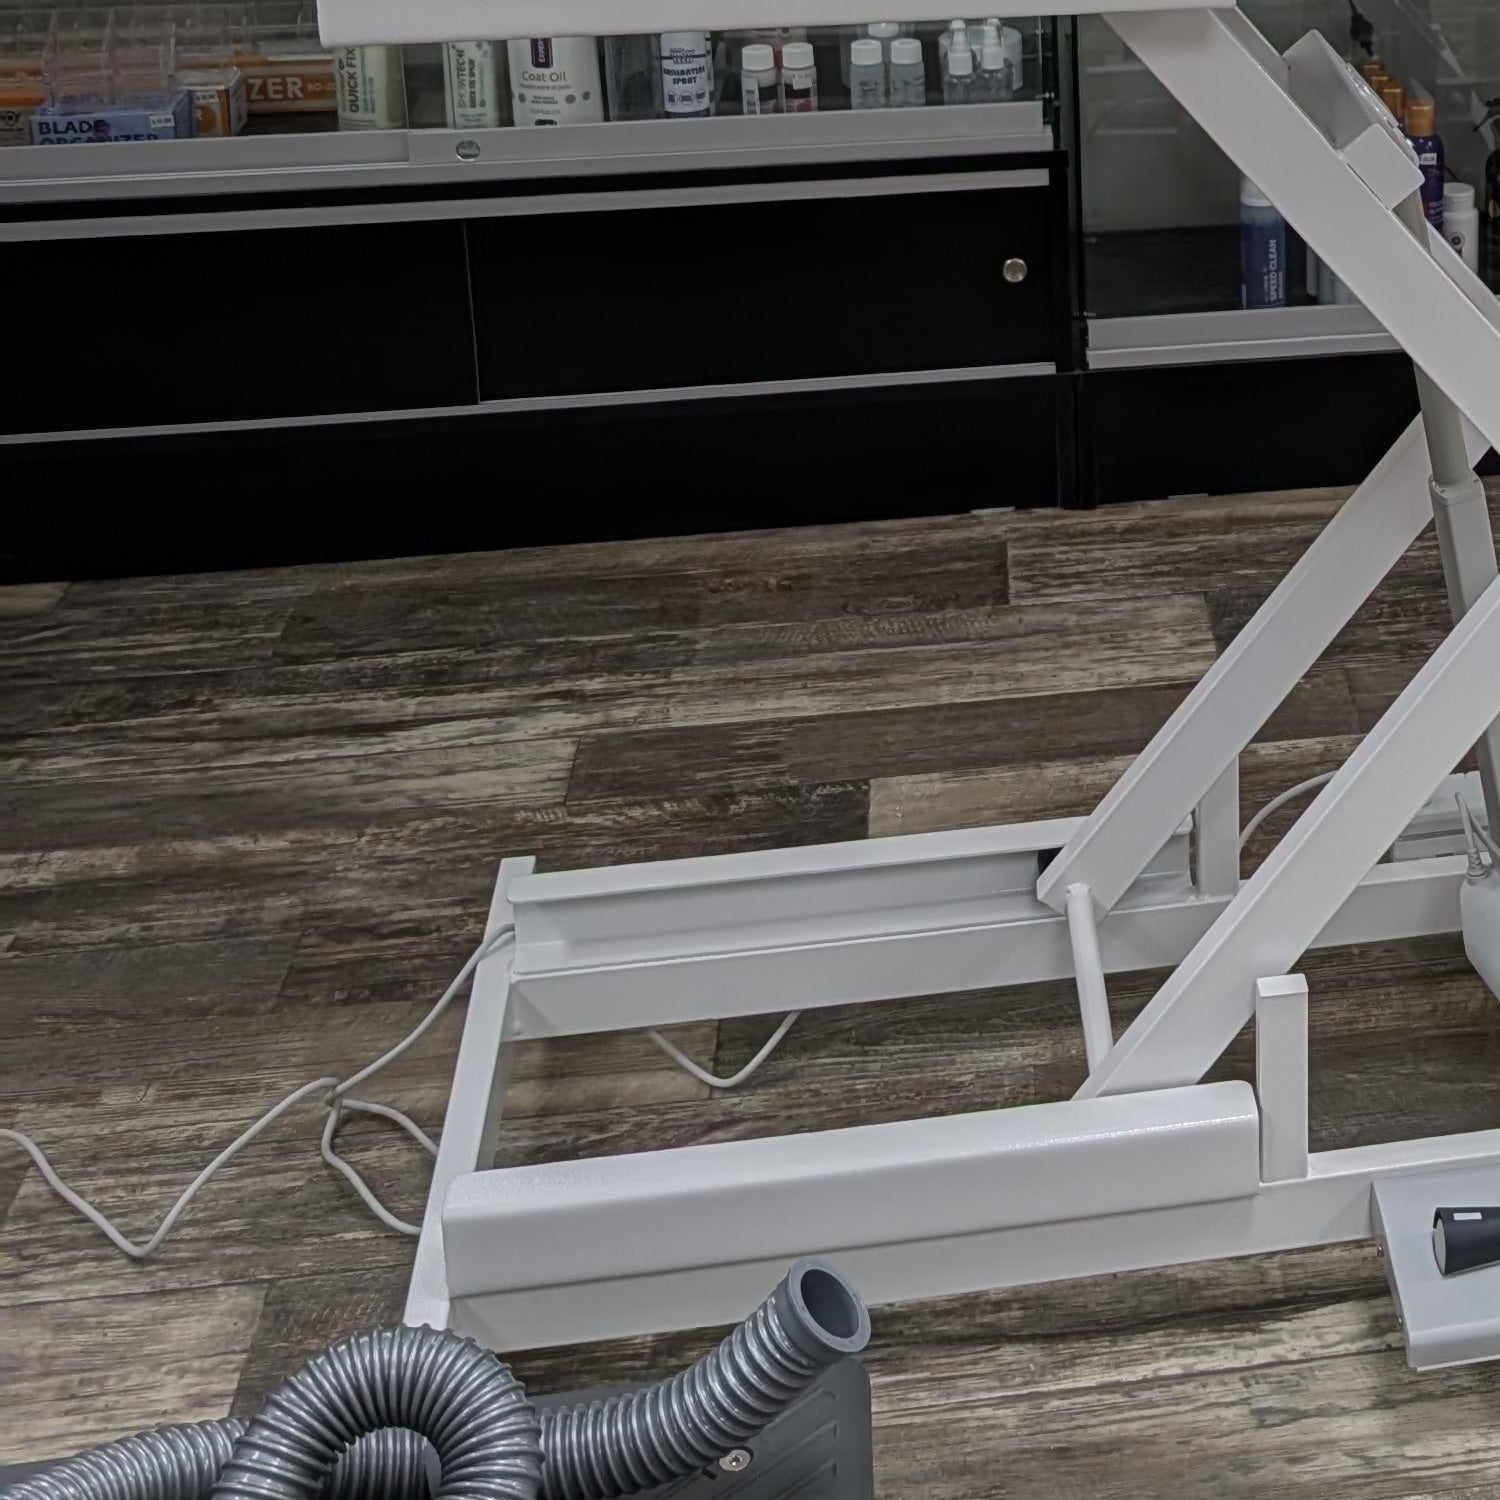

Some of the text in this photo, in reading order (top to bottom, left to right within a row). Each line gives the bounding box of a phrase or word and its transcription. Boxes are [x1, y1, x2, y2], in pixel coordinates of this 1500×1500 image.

[344, 47, 360, 114] QUICK FIX
[521, 71, 567, 82] Coat Oil
[39, 119, 110, 135] BLADE
